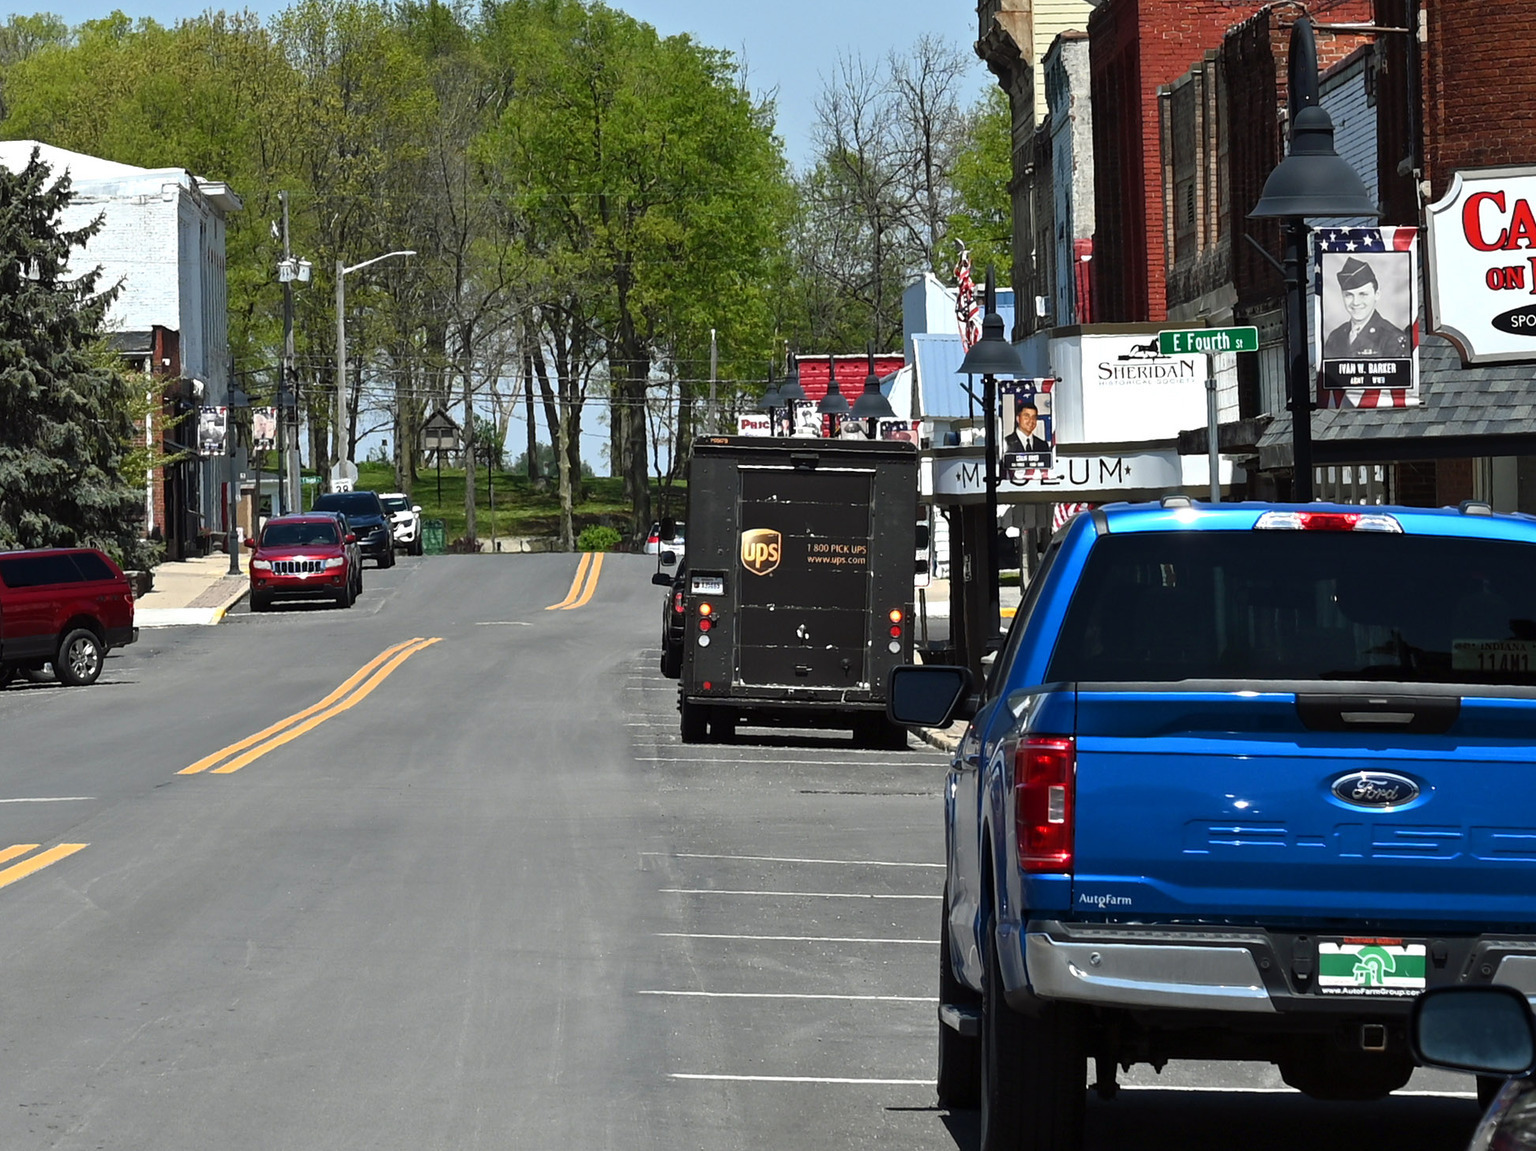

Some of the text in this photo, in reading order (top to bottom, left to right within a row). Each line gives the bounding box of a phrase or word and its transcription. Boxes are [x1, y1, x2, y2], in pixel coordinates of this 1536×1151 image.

[1462, 190, 1536, 251] CA
[1486, 266, 1525, 290] ON
[1510, 314, 1536, 328] SPO
[1173, 331, 1244, 351] E Fourth St
[1098, 360, 1195, 380] SHERIDAN
[1338, 363, 1356, 374] IVAN
[1368, 362, 1397, 374] BARKER
[962, 457, 1123, 489] MUM
[745, 543, 778, 568] ups
[814, 544, 829, 553] 800
[831, 544, 849, 554] PICK
[851, 545, 867, 555] UPS
[807, 556, 866, 565] www.ups.com
[1480, 643, 1527, 651] INDIANA
[1352, 779, 1398, 800] Ford
[1079, 893, 1132, 906] AutoFarm
